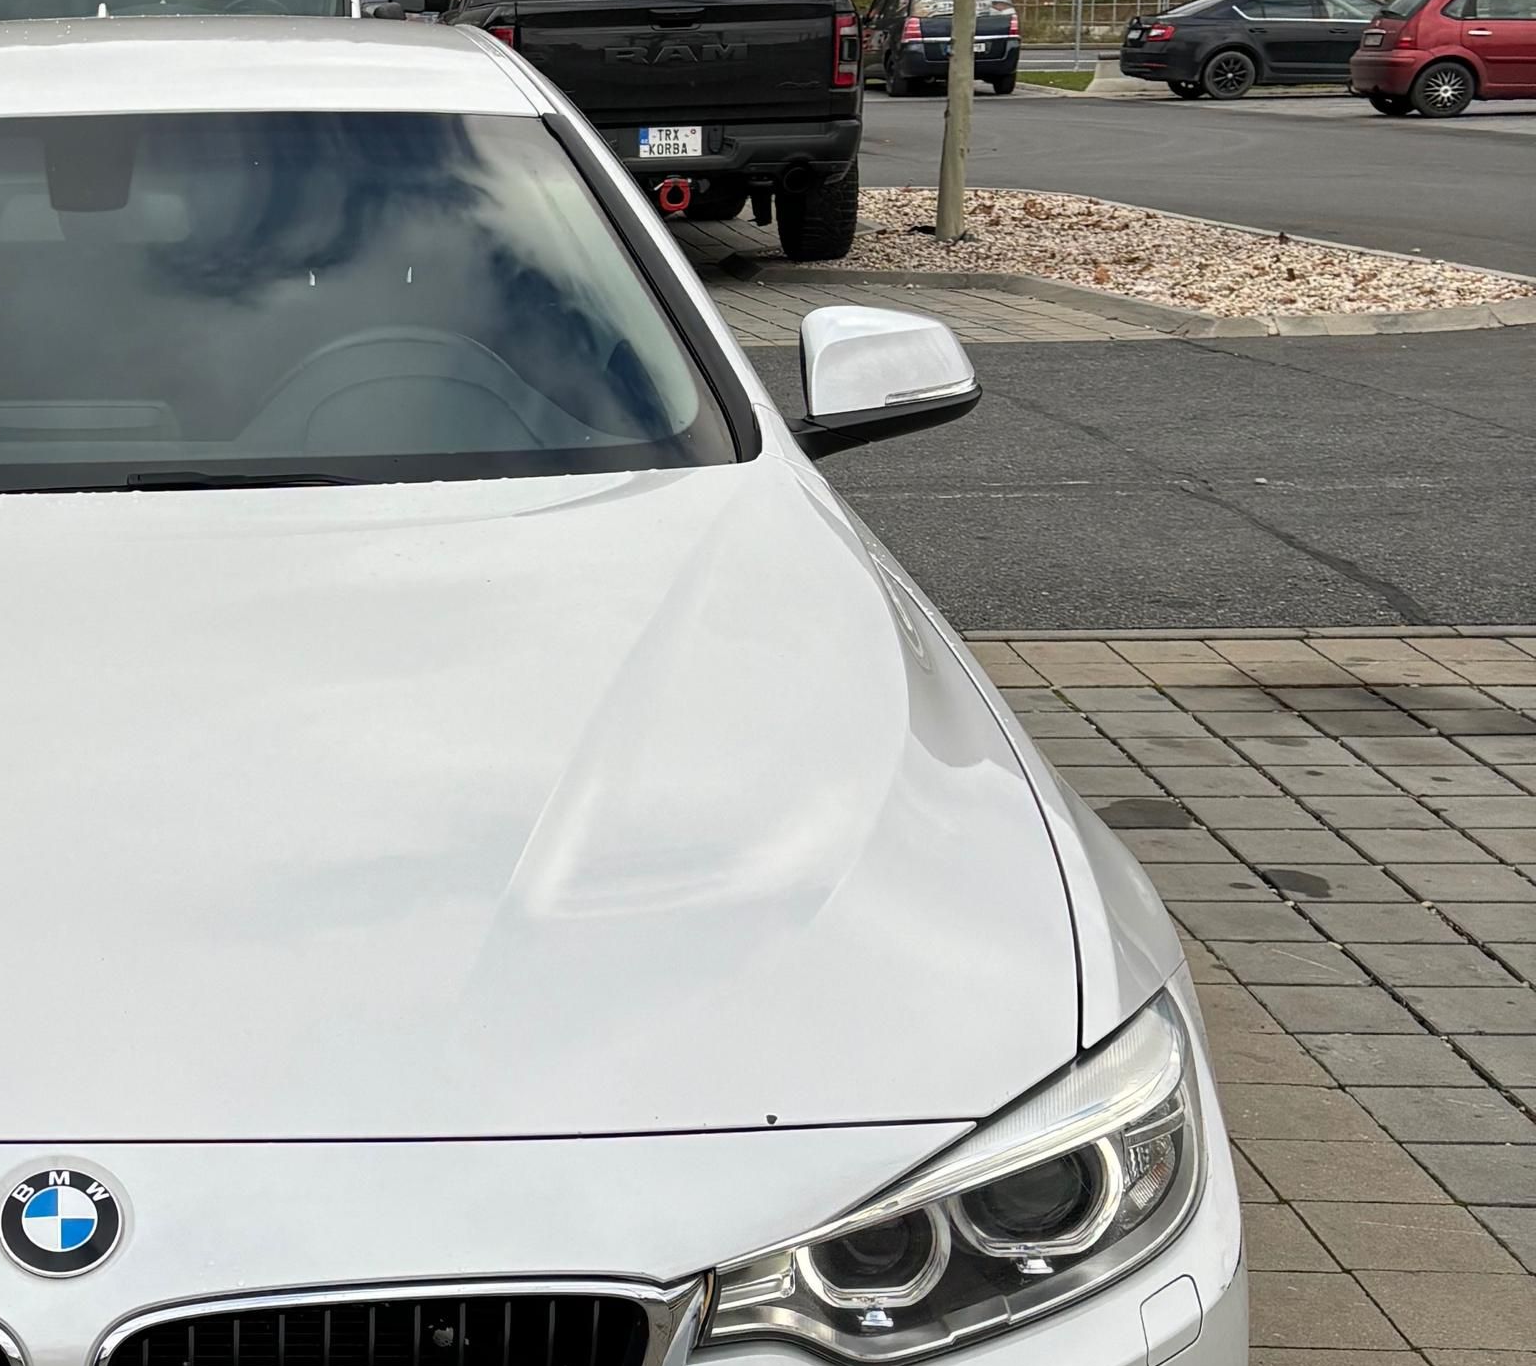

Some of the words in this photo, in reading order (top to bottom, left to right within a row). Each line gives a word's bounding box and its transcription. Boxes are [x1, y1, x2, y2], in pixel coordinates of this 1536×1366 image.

[605, 43, 748, 64] RAM
[657, 129, 680, 141] TRX
[649, 143, 688, 155] KORBA
[11, 1171, 110, 1203] BMW
